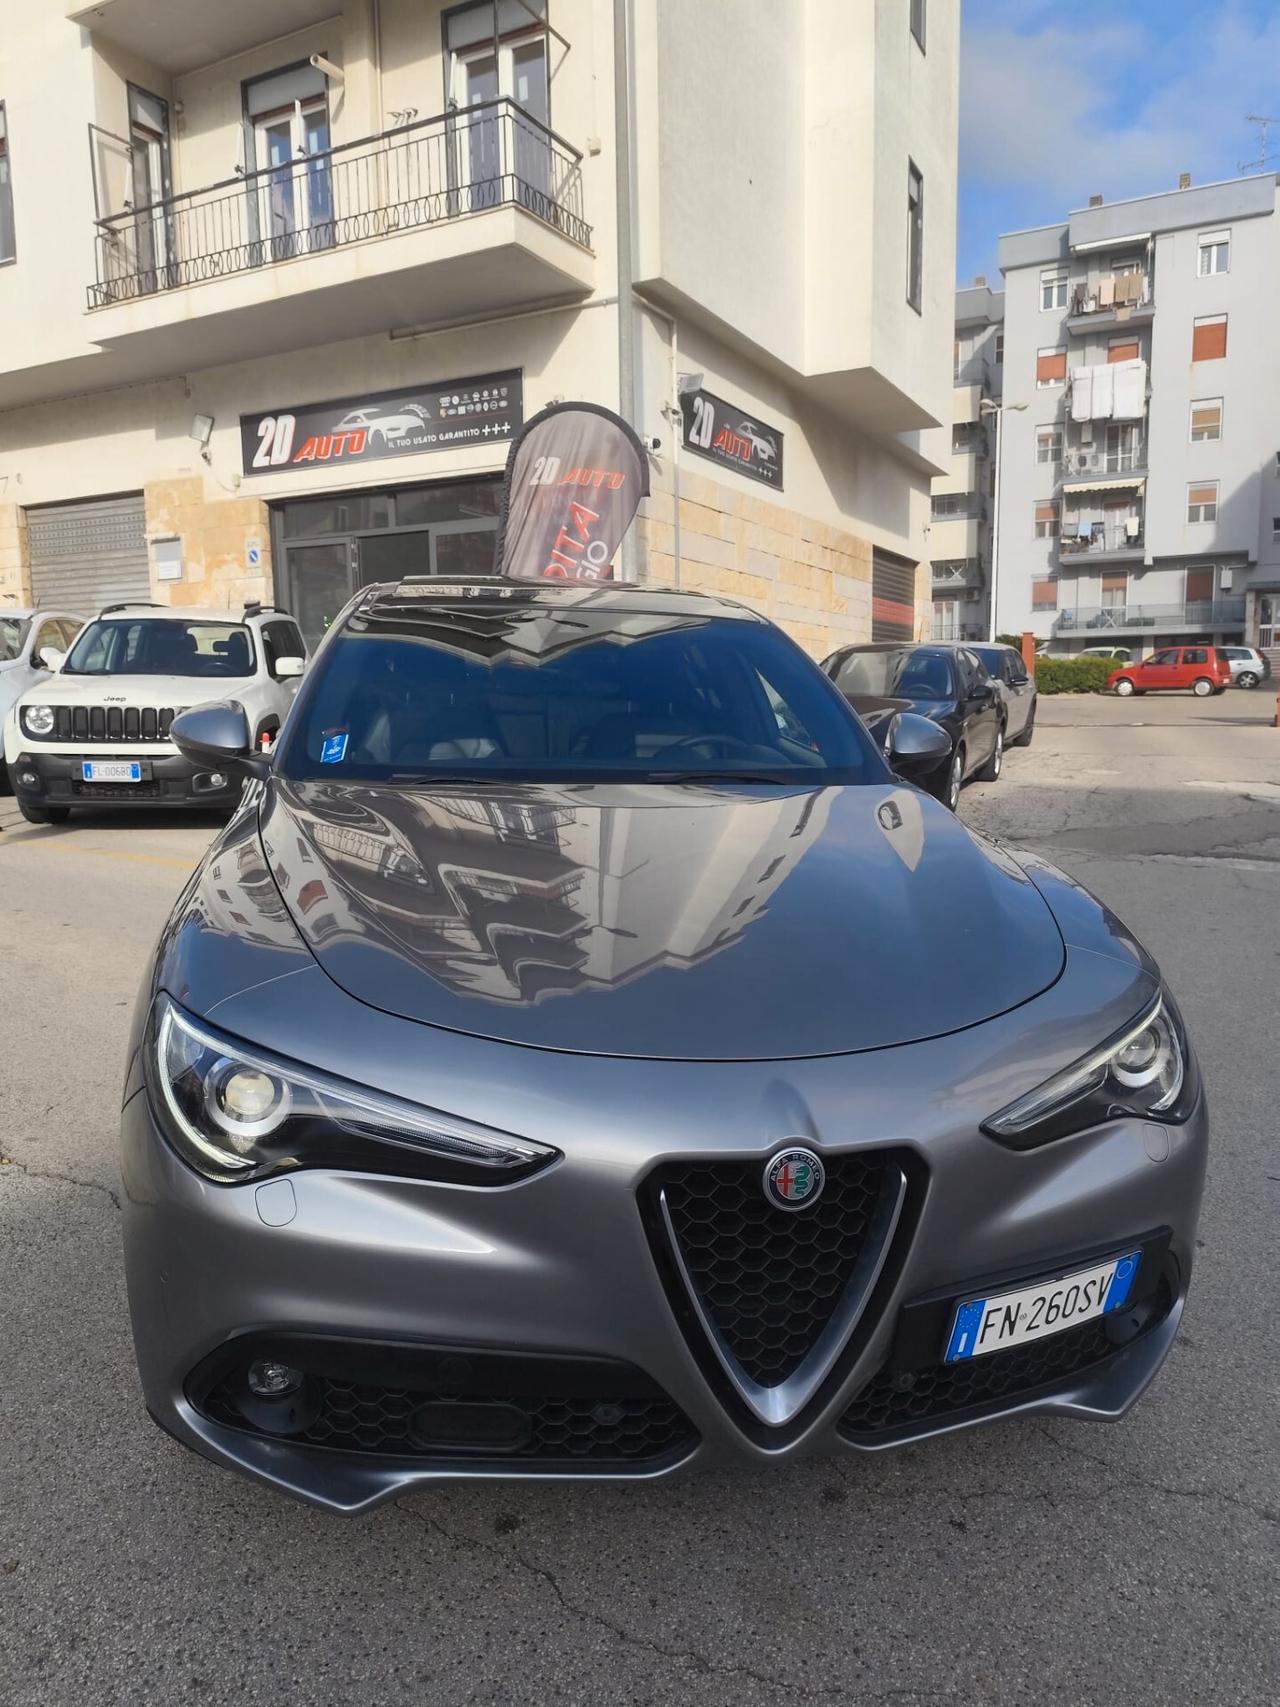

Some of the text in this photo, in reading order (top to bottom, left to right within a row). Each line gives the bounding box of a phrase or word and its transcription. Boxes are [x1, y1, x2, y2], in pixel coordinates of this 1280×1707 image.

[293, 431, 367, 463] AUTO
[397, 436, 411, 447] TUO
[413, 432, 437, 444] USATO
[439, 428, 480, 440] GARANTITO
[713, 427, 752, 461] AUTO
[559, 467, 626, 489] AUTO
[103, 695, 127, 703] Jeep
[770, 1154, 820, 1182] ALFA ROMEO
